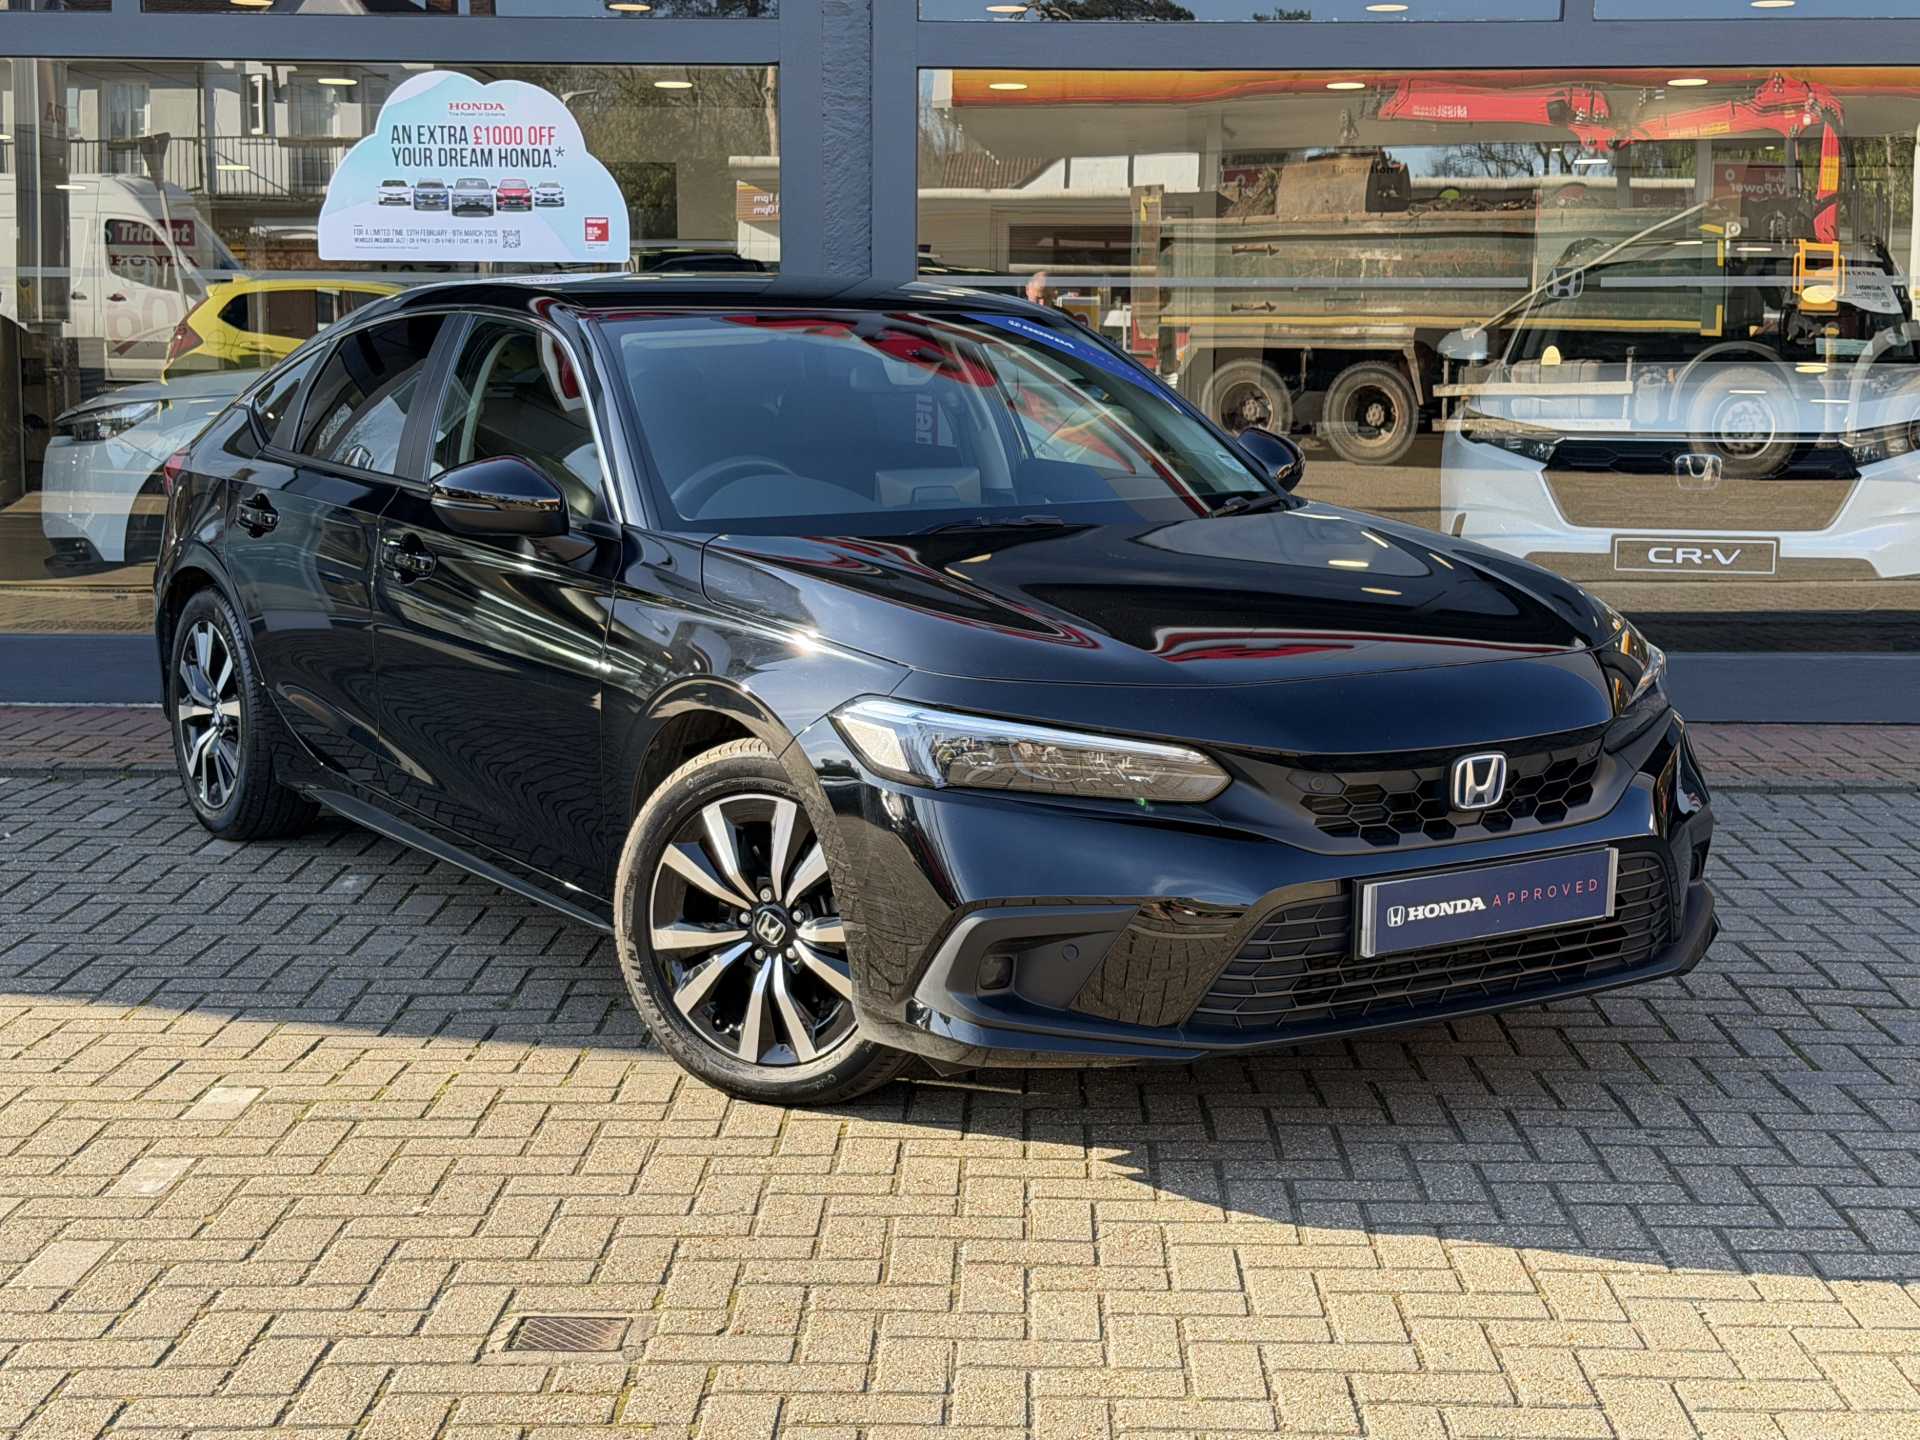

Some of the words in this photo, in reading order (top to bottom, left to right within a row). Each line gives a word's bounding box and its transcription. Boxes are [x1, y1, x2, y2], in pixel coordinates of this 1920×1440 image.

[448, 102, 505, 111] HONDA
[391, 125, 412, 145] AN
[418, 125, 469, 145] EXTRA
[473, 126, 523, 145] £1000
[528, 126, 556, 146] OFF
[392, 147, 433, 167] YOUR
[438, 148, 493, 168] DREAM
[1647, 547, 1741, 565] CR-V
[1407, 897, 1486, 921] HONDA
[1492, 879, 1599, 907] APPROVED
